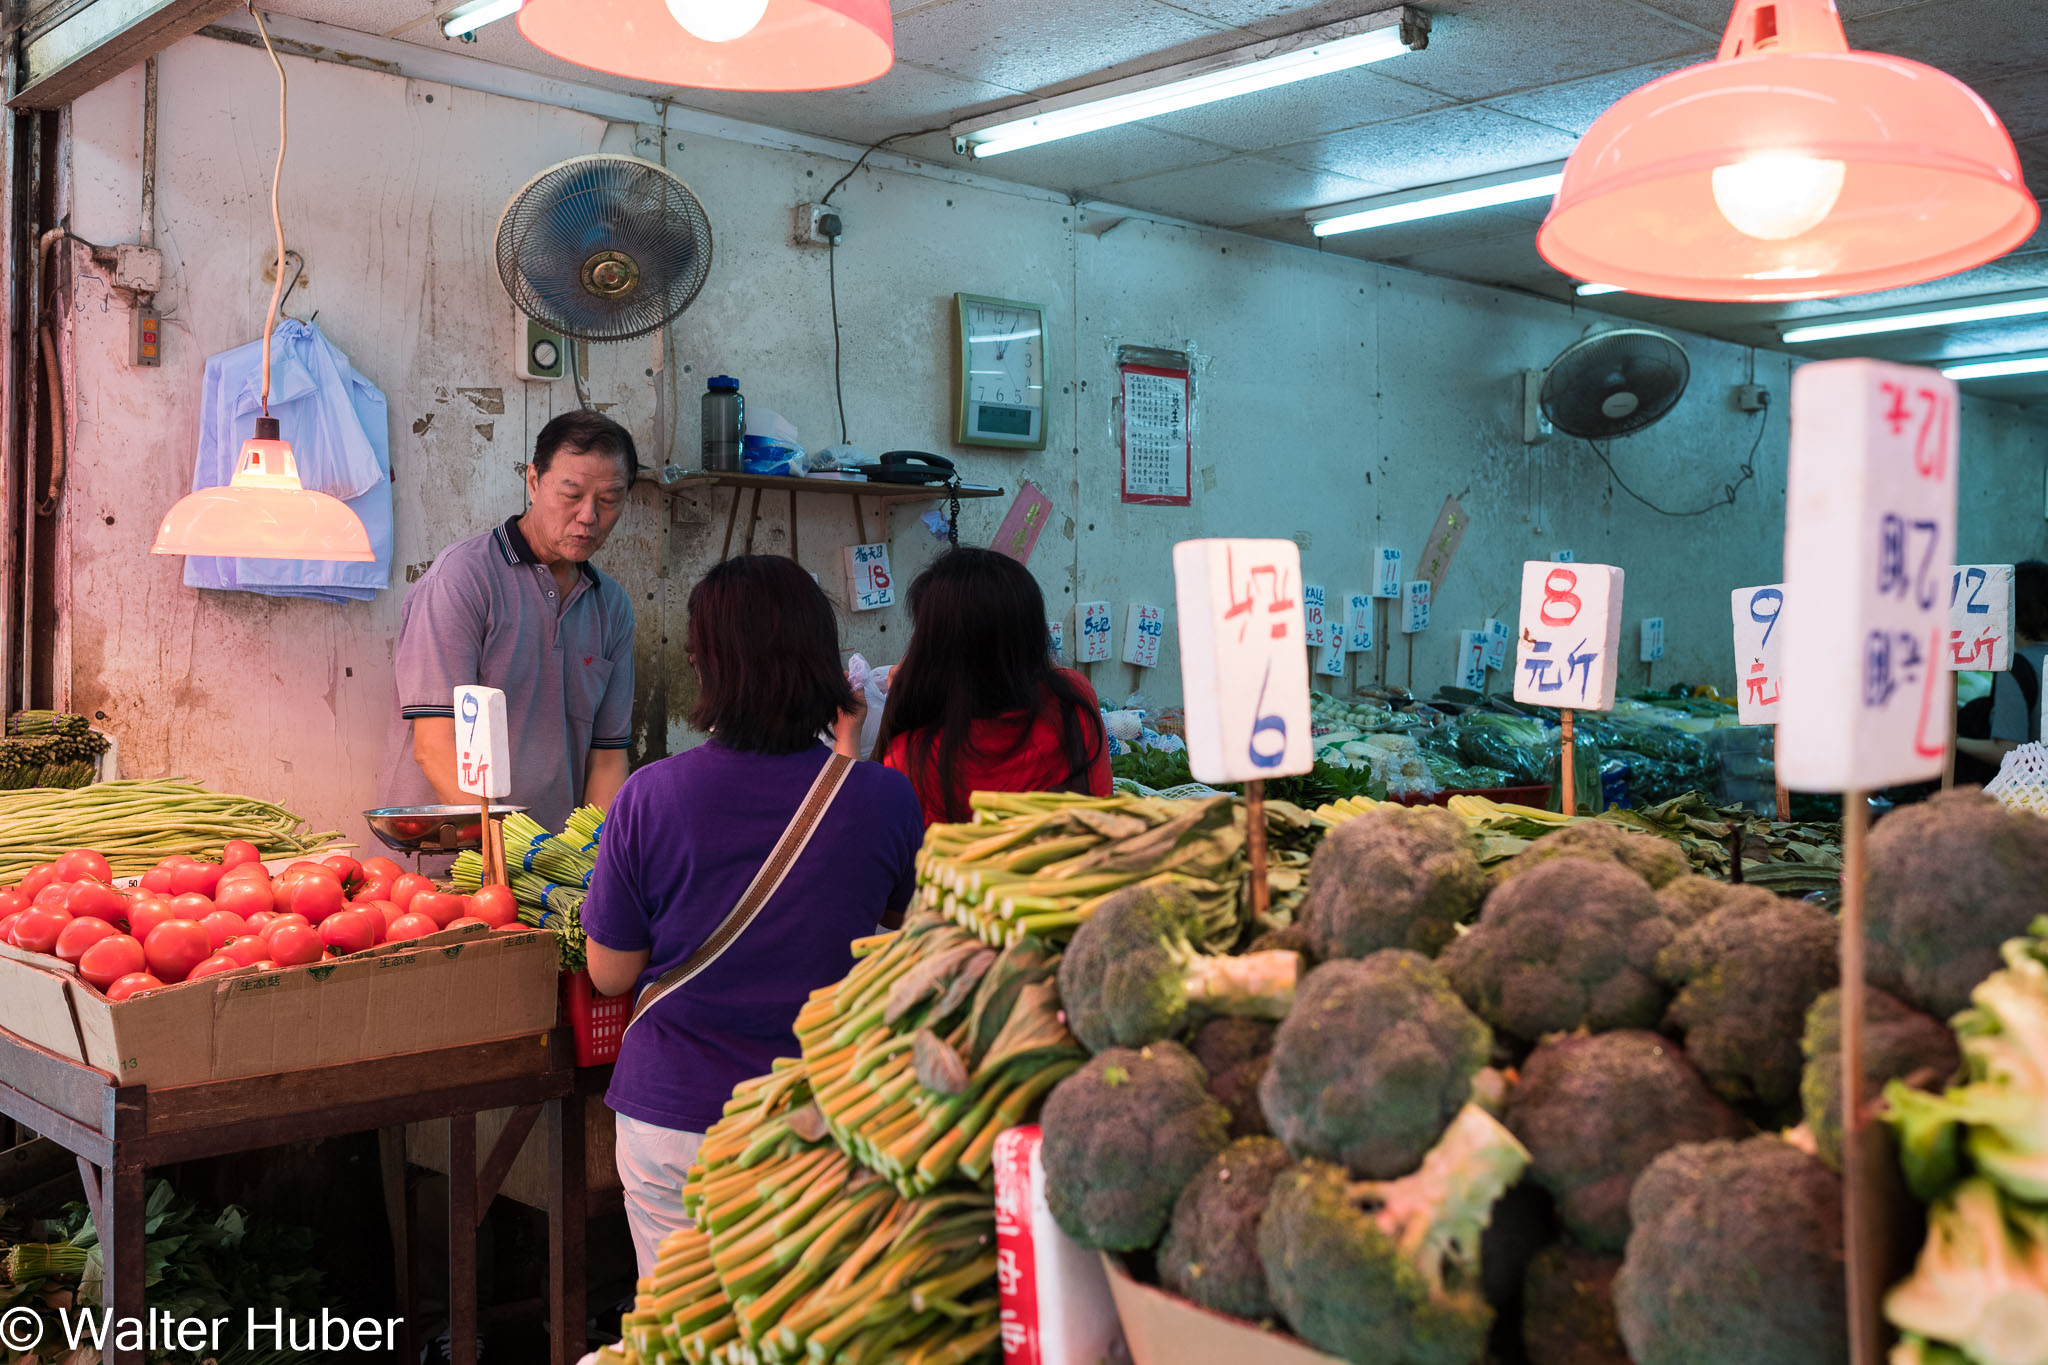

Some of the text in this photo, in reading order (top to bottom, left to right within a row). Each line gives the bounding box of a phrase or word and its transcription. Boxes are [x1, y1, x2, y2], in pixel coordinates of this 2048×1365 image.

[994, 310, 1004, 325] 12
[1024, 352, 1032, 368] 3
[978, 386, 985, 401] 7
[996, 387, 1004, 402] 6
[868, 564, 890, 590] 18
[1305, 586, 1324, 601] KALE
[1540, 568, 1582, 627] 8
[1950, 568, 1990, 614] 12
[1309, 607, 1322, 625] 18
[1751, 589, 1784, 650] 9
[1332, 635, 1342, 659] 9
[1472, 644, 1483, 672] 7
[1950, 626, 2002, 670] 元斤
[1524, 637, 1598, 703] 元斤
[1747, 663, 1784, 706] 元
[462, 692, 479, 747] 9
[128, 879, 138, 888] 50
[504, 933, 537, 947] 生态菇
[379, 954, 416, 969] 生态菇
[240, 975, 281, 991] 生态菇
